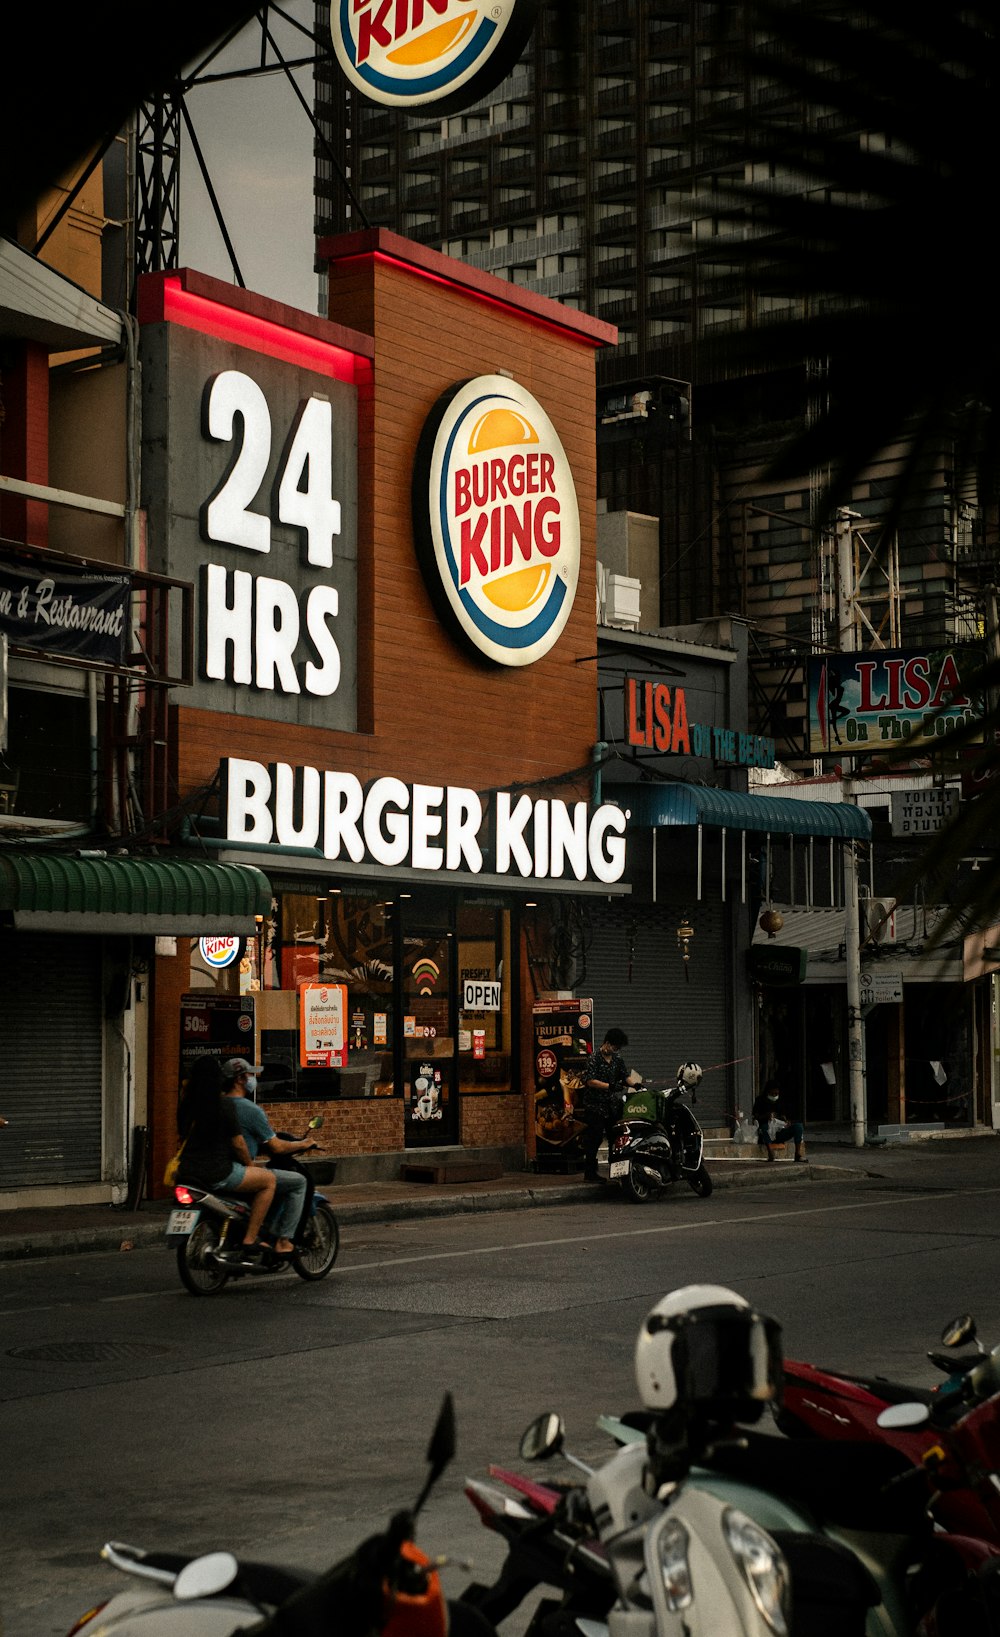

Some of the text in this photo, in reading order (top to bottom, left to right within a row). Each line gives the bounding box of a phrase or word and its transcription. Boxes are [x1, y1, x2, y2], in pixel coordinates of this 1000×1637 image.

[207, 370, 341, 568] 24
[455, 453, 556, 518] BURGER
[460, 496, 561, 586] KING
[17, 585, 30, 619] &
[34, 578, 124, 638] Restaurant
[206, 563, 341, 696] HRS
[855, 653, 972, 713] LISA
[628, 678, 776, 769] LISA ON THE BEACH
[846, 717, 869, 743] On
[877, 714, 913, 741] The
[226, 757, 627, 884] BURGER KING
[904, 792, 952, 802] TOILET
[206, 936, 234, 956] KING
[461, 968, 491, 978] FRESHLY
[466, 985, 499, 1006] OPEN
[536, 1025, 574, 1036] TRUFFLE
[627, 1104, 648, 1114] Grab
